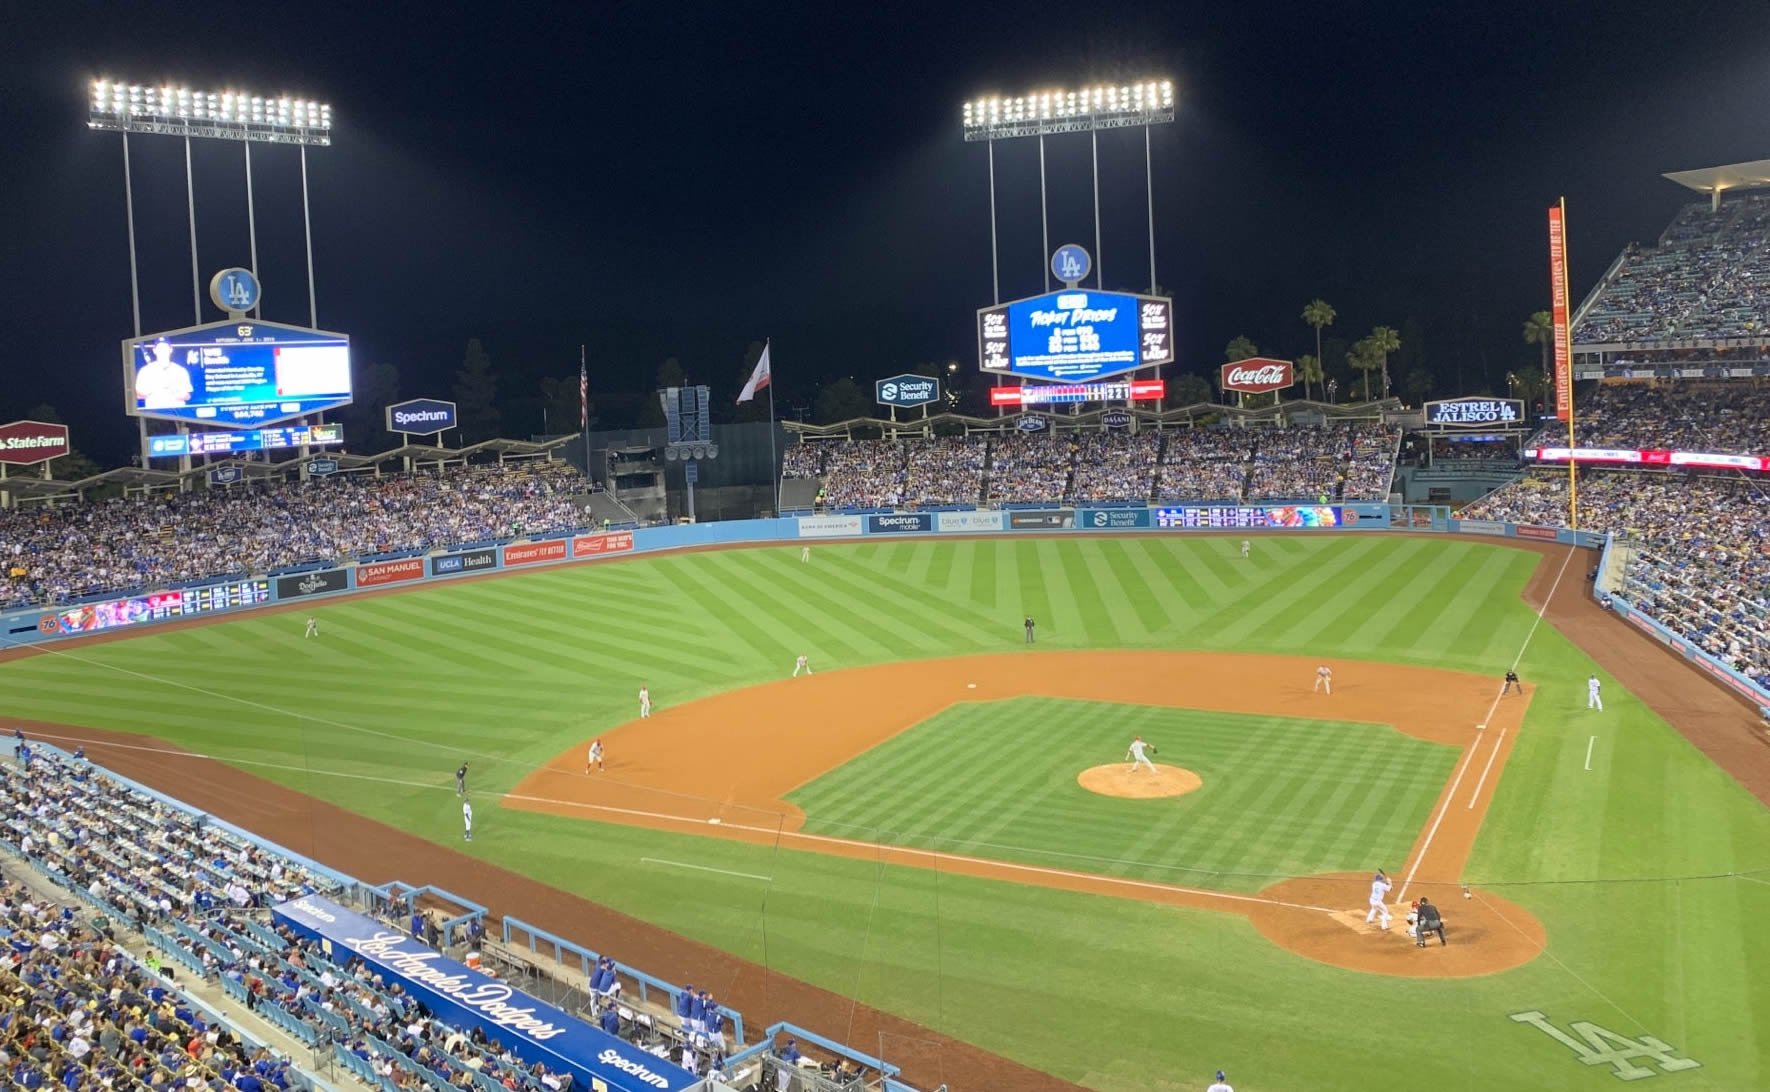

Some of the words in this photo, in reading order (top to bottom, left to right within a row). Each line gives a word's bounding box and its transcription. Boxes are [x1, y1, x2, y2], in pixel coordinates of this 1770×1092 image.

[1061, 250, 1080, 277] LA
[227, 275, 250, 304] LA
[1228, 365, 1287, 386] Coca-Cola
[899, 381, 934, 392] Security
[900, 391, 929, 400] Benefit
[395, 410, 448, 425] Spectrum
[1104, 416, 1130, 424] DASANI
[1433, 411, 1498, 423] JALISCO
[879, 516, 920, 527] Spectrum
[1109, 511, 1139, 521] Security
[1110, 518, 1135, 527] Benefit
[439, 559, 459, 569] UCLA
[463, 554, 492, 567] Health
[505, 549, 538, 562] Emirates
[368, 567, 386, 577] SAN
[386, 561, 422, 575] MANUEL
[42, 618, 56, 629] 76
[292, 900, 336, 923] Spectrum
[345, 931, 407, 957] Los
[391, 950, 473, 998] Angeles
[461, 983, 568, 1040] Dodgers
[1508, 1010, 1704, 1082] LA
[597, 1049, 669, 1090] Spectrum
